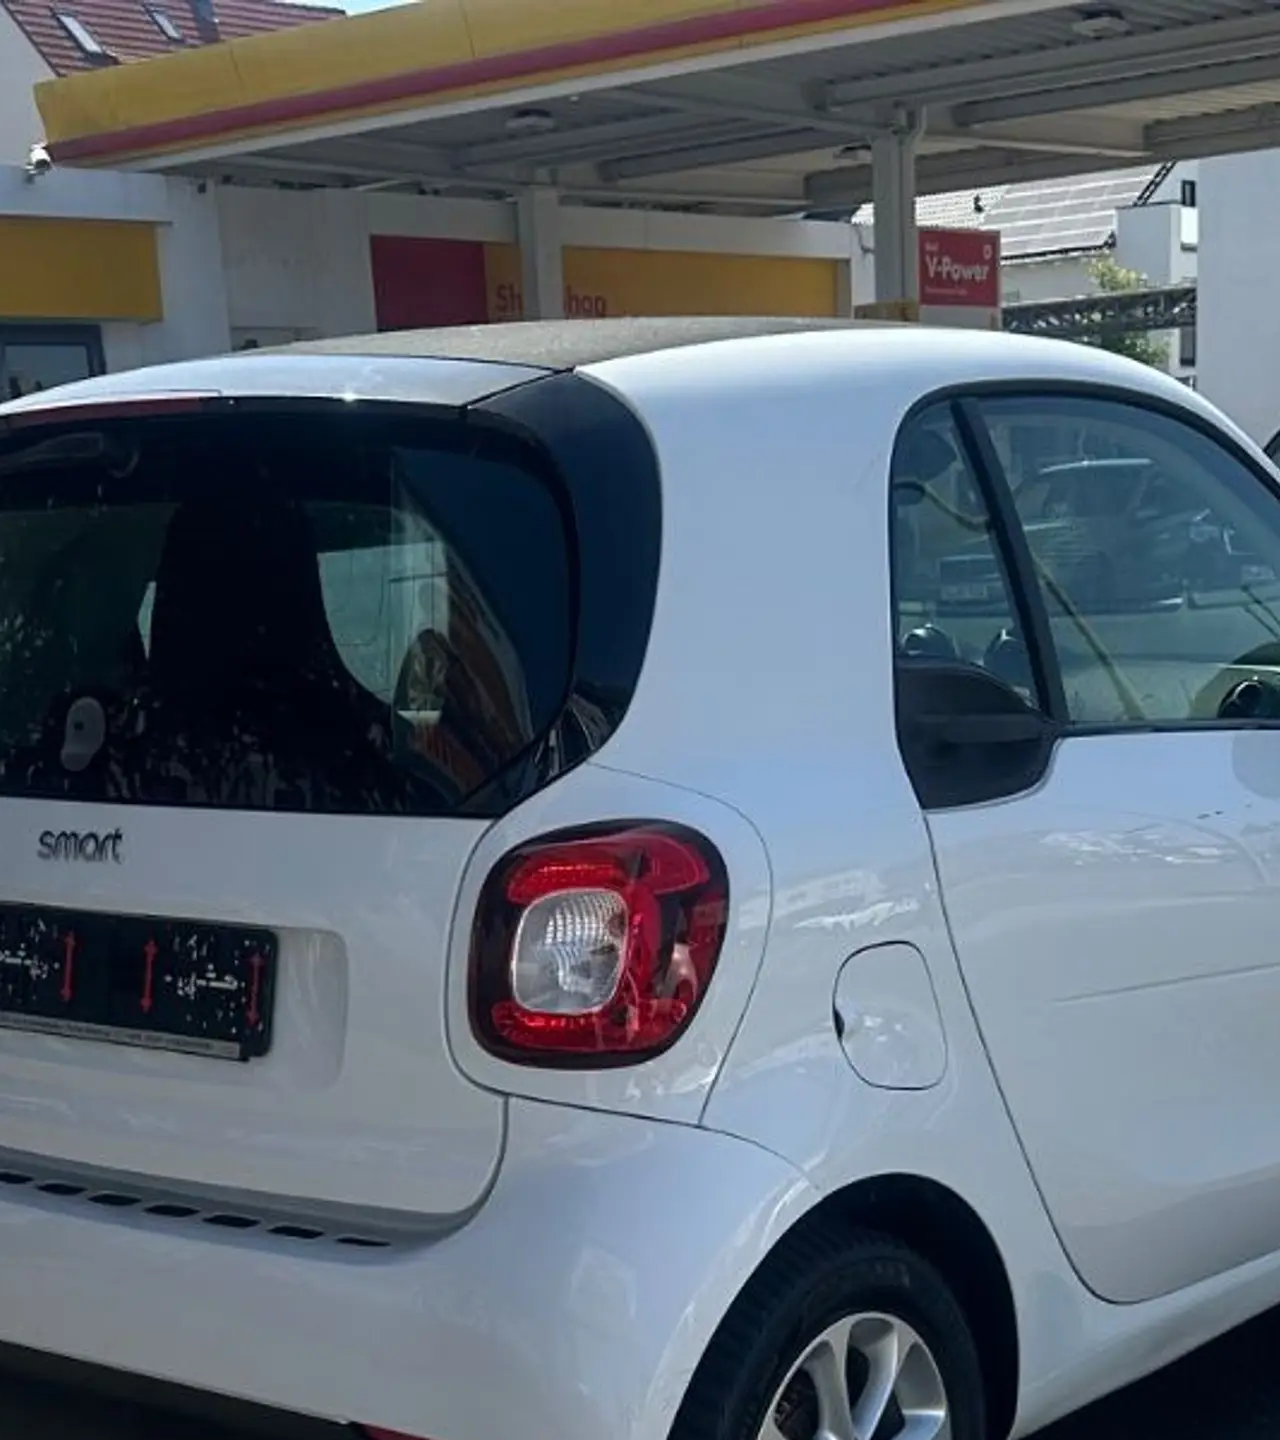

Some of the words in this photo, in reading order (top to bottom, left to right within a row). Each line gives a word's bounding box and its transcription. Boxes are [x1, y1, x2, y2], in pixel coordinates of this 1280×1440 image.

[925, 255, 989, 282] V-Power
[564, 285, 606, 318] hop
[37, 828, 123, 864] smart
